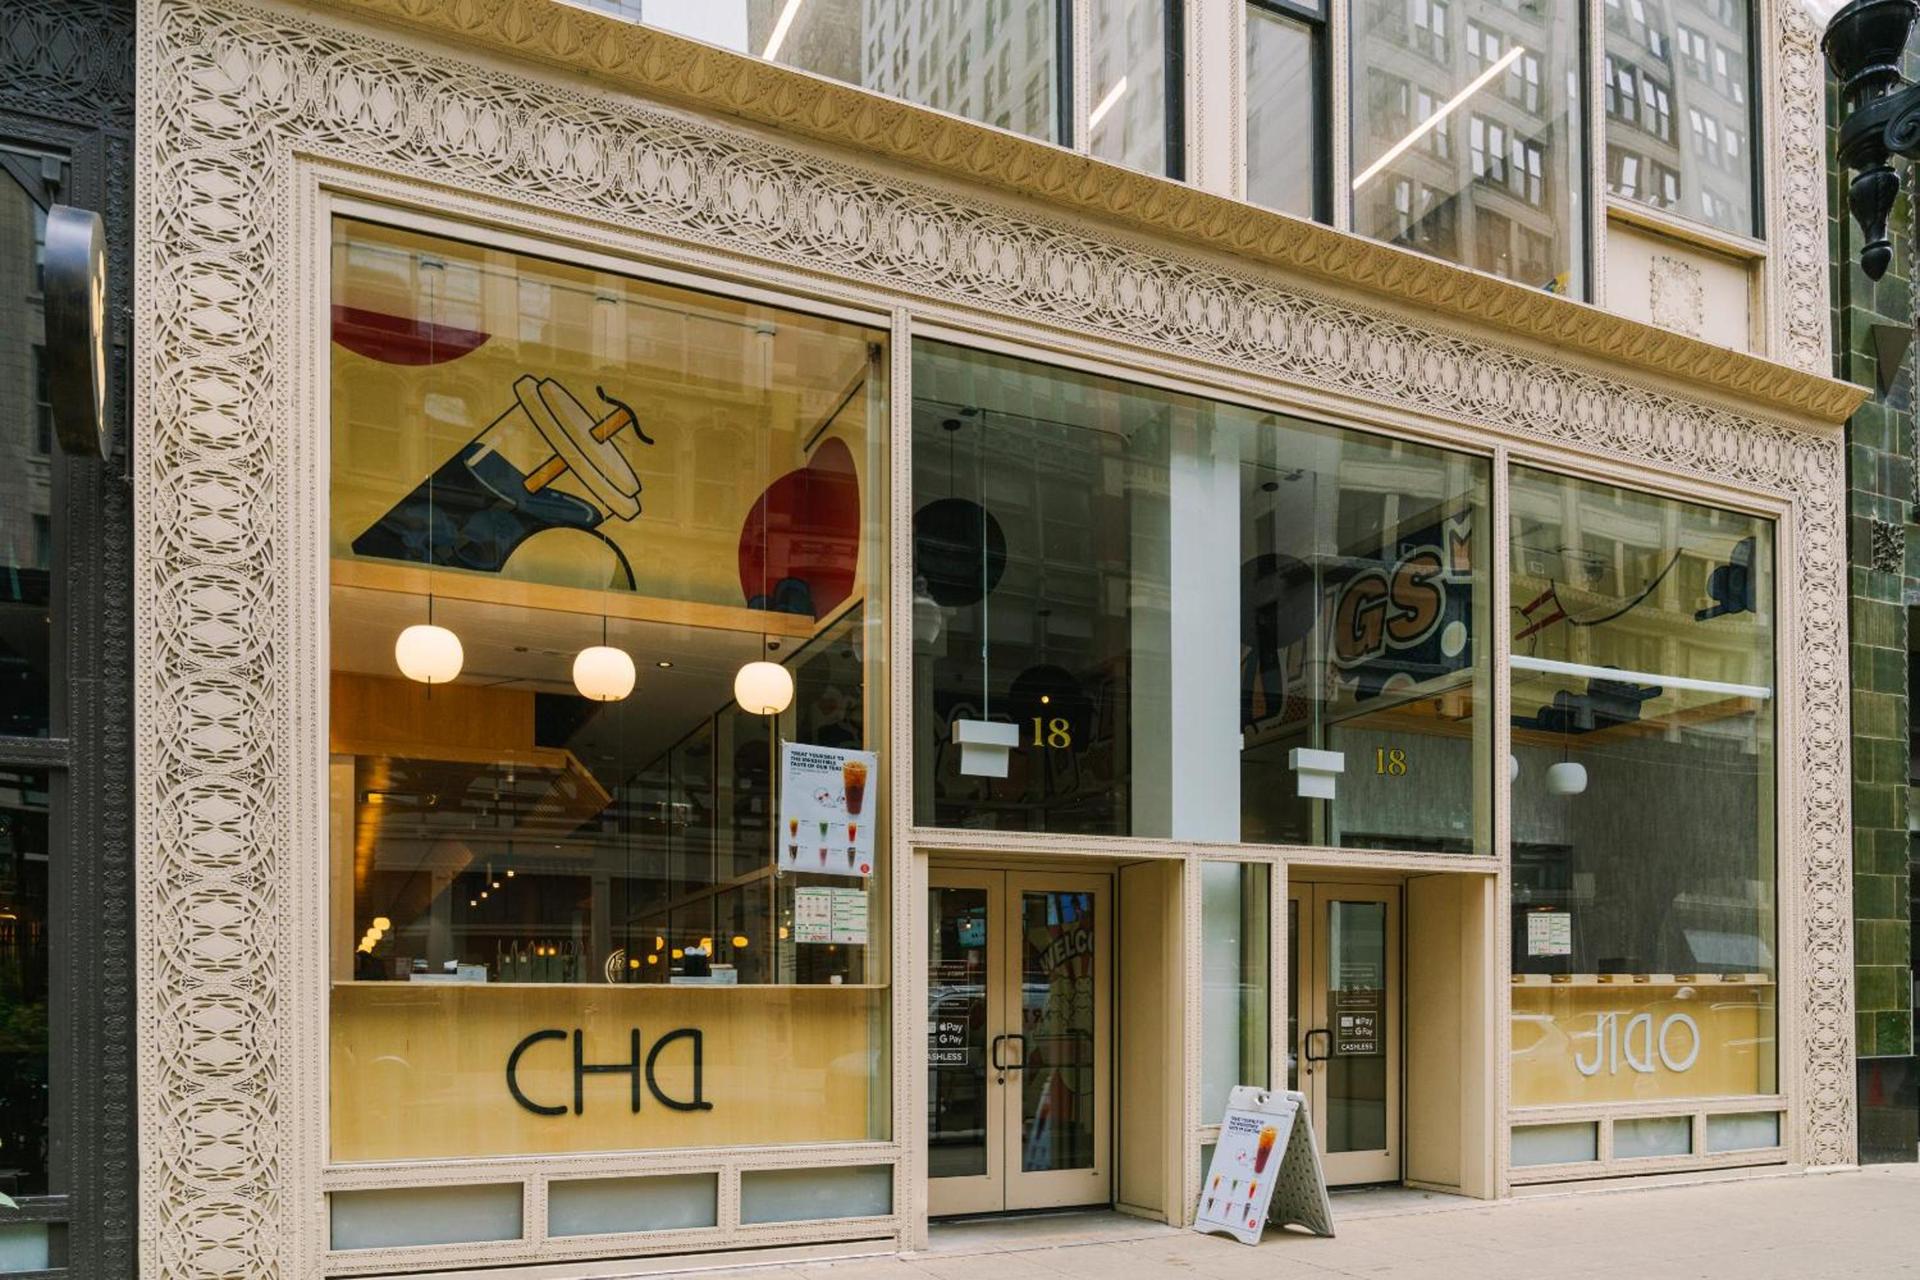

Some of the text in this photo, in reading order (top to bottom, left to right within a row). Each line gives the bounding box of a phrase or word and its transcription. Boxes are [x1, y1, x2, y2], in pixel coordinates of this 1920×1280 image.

[1032, 717, 1072, 749] 18
[1376, 747, 1408, 777] 18
[949, 1035, 963, 1046] Pay
[1341, 1043, 1374, 1051] CASHLESS
